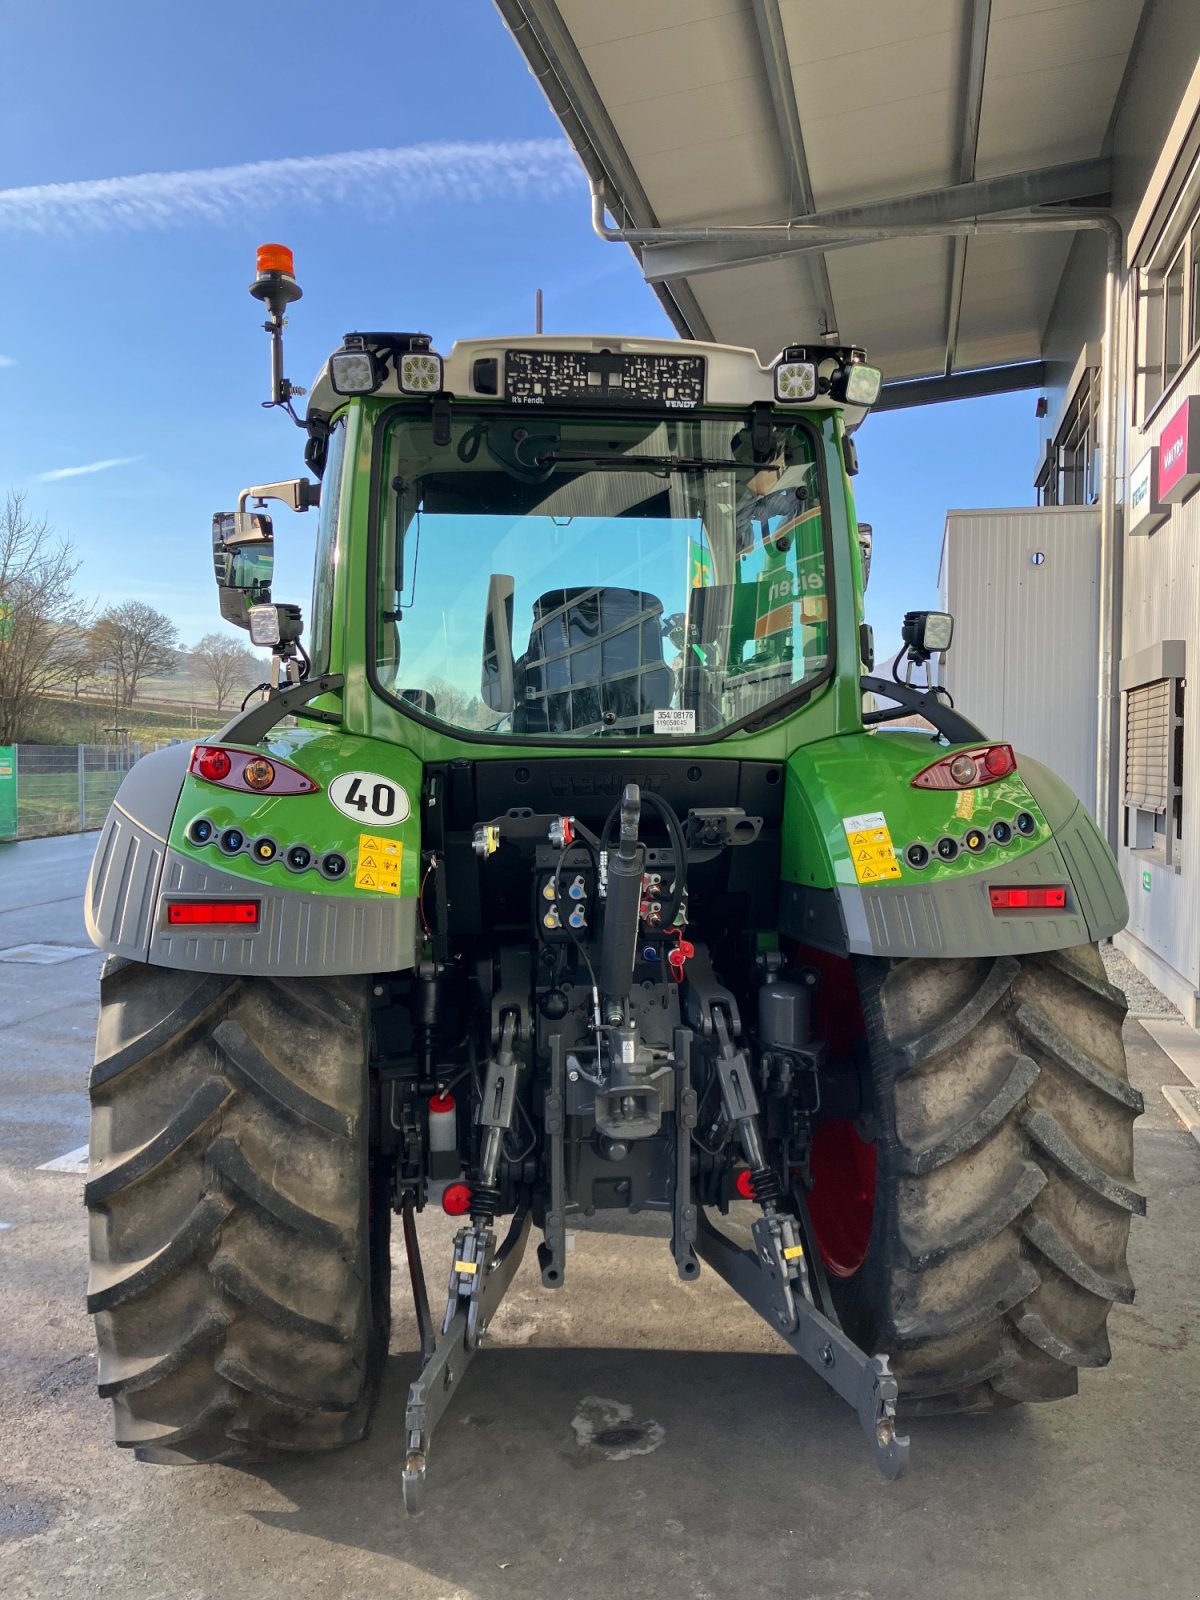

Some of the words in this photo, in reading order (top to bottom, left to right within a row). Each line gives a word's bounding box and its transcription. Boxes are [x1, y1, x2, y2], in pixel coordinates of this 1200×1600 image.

[511, 395, 521, 403] It's
[665, 400, 698, 409] FENDT
[344, 778, 396, 817] 40
